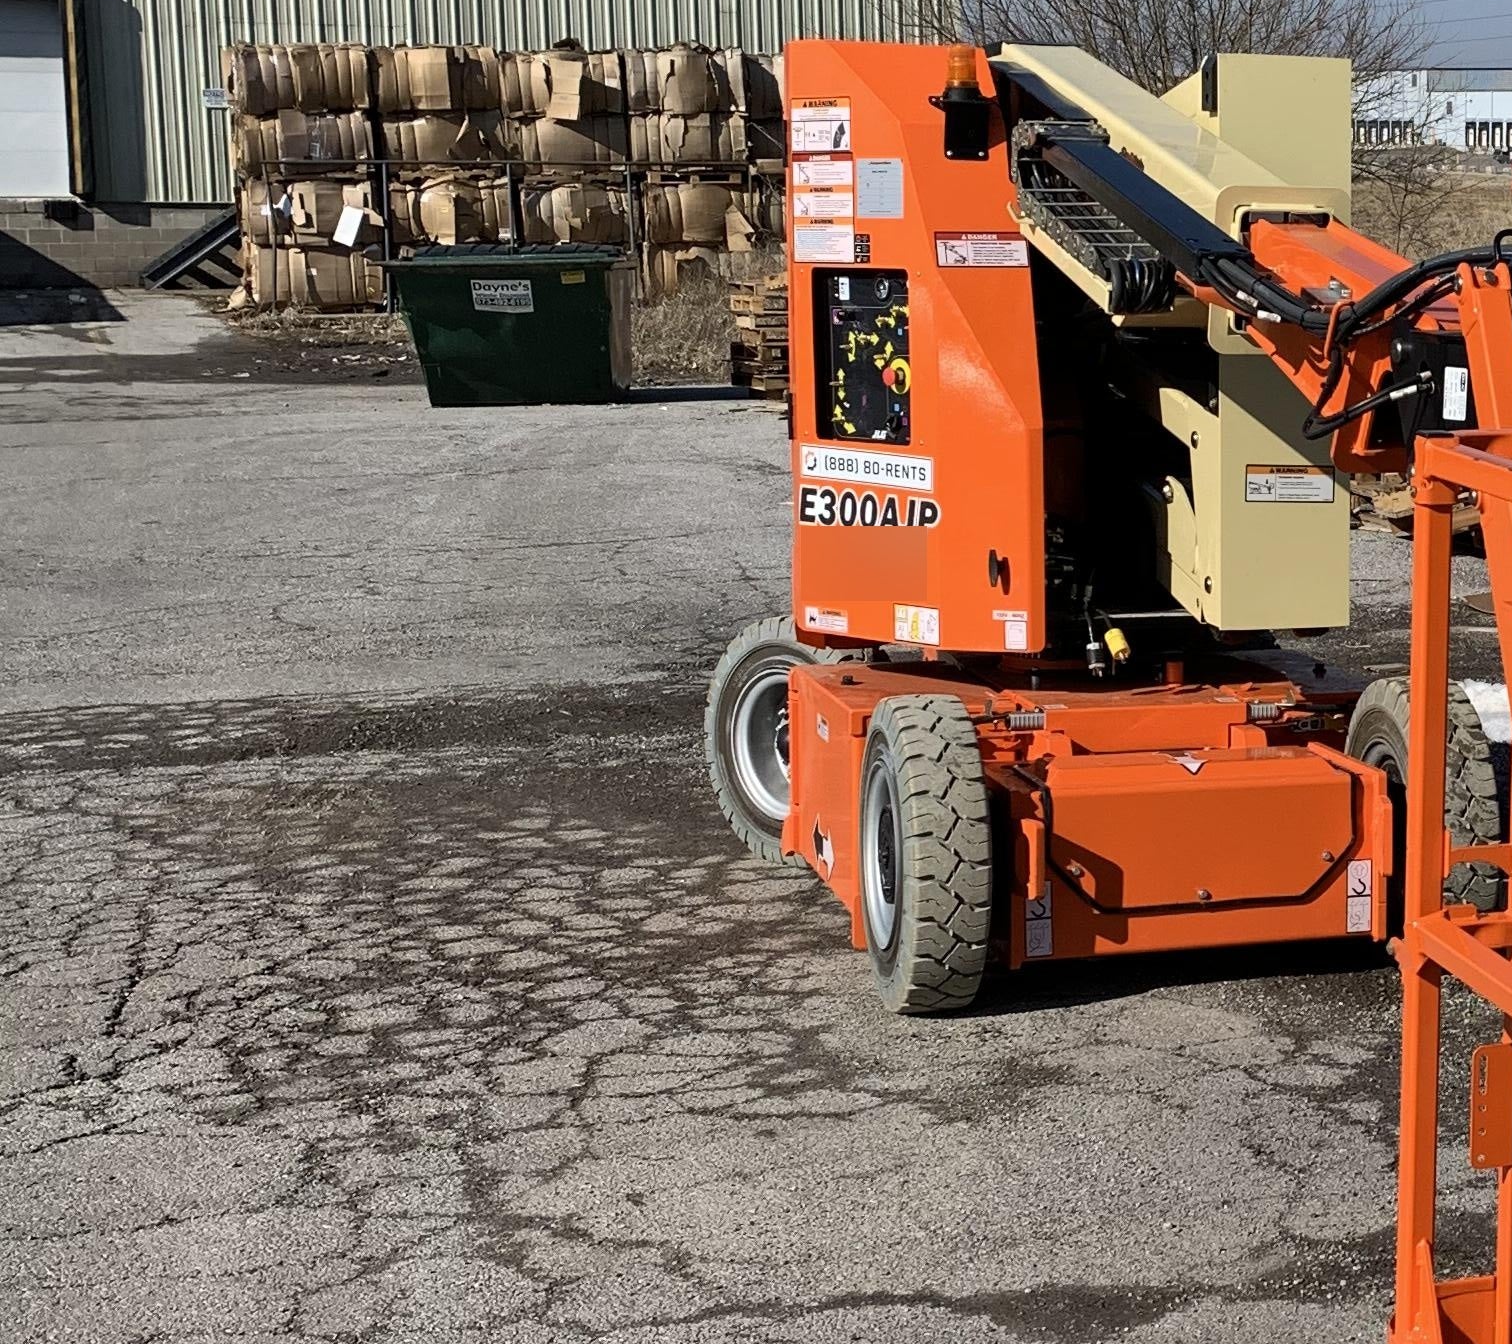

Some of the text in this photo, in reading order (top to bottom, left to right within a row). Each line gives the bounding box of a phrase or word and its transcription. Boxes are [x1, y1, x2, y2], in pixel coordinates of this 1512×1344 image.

[473, 281, 530, 292] Dayne's
[872, 430, 887, 439] JLG
[824, 455, 926, 481] (888) 80-RENTS
